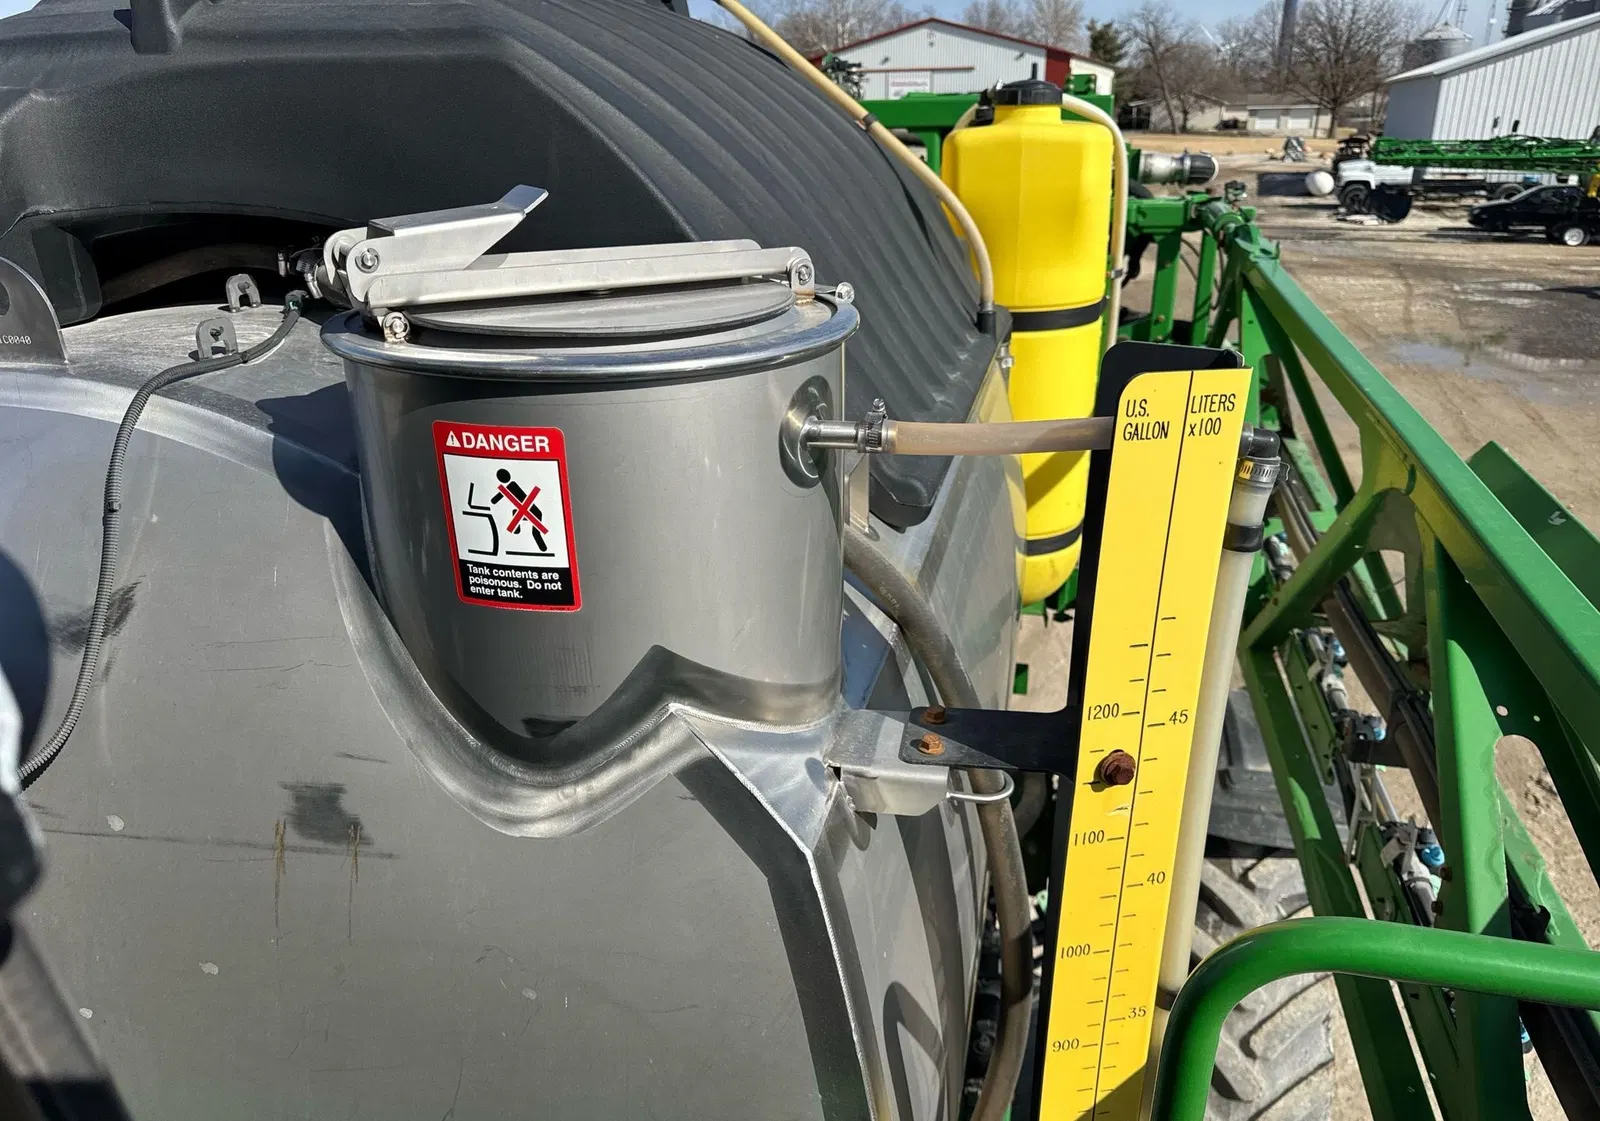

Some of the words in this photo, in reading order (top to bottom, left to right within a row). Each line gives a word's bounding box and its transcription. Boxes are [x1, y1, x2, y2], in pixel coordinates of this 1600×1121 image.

[1125, 398, 1150, 418] U.S.
[1190, 393, 1236, 414] LITERS
[1123, 421, 1170, 441] GALLON
[1187, 417, 1222, 437] x100
[462, 432, 550, 452] DANGER
[467, 564, 491, 575] Tank
[492, 569, 539, 580] contents
[541, 572, 560, 580] are
[469, 576, 523, 590] poisonous.
[527, 580, 542, 591] Do
[544, 582, 563, 591] not
[470, 587, 495, 596] enter
[496, 589, 524, 599] tank.
[1087, 702, 1120, 721] 1200
[1169, 709, 1188, 724] 45
[1074, 829, 1105, 847] 1100
[1146, 871, 1166, 886] 40
[1060, 943, 1091, 960] 1000
[1128, 1006, 1146, 1019] 35
[1052, 1038, 1080, 1054] 900
